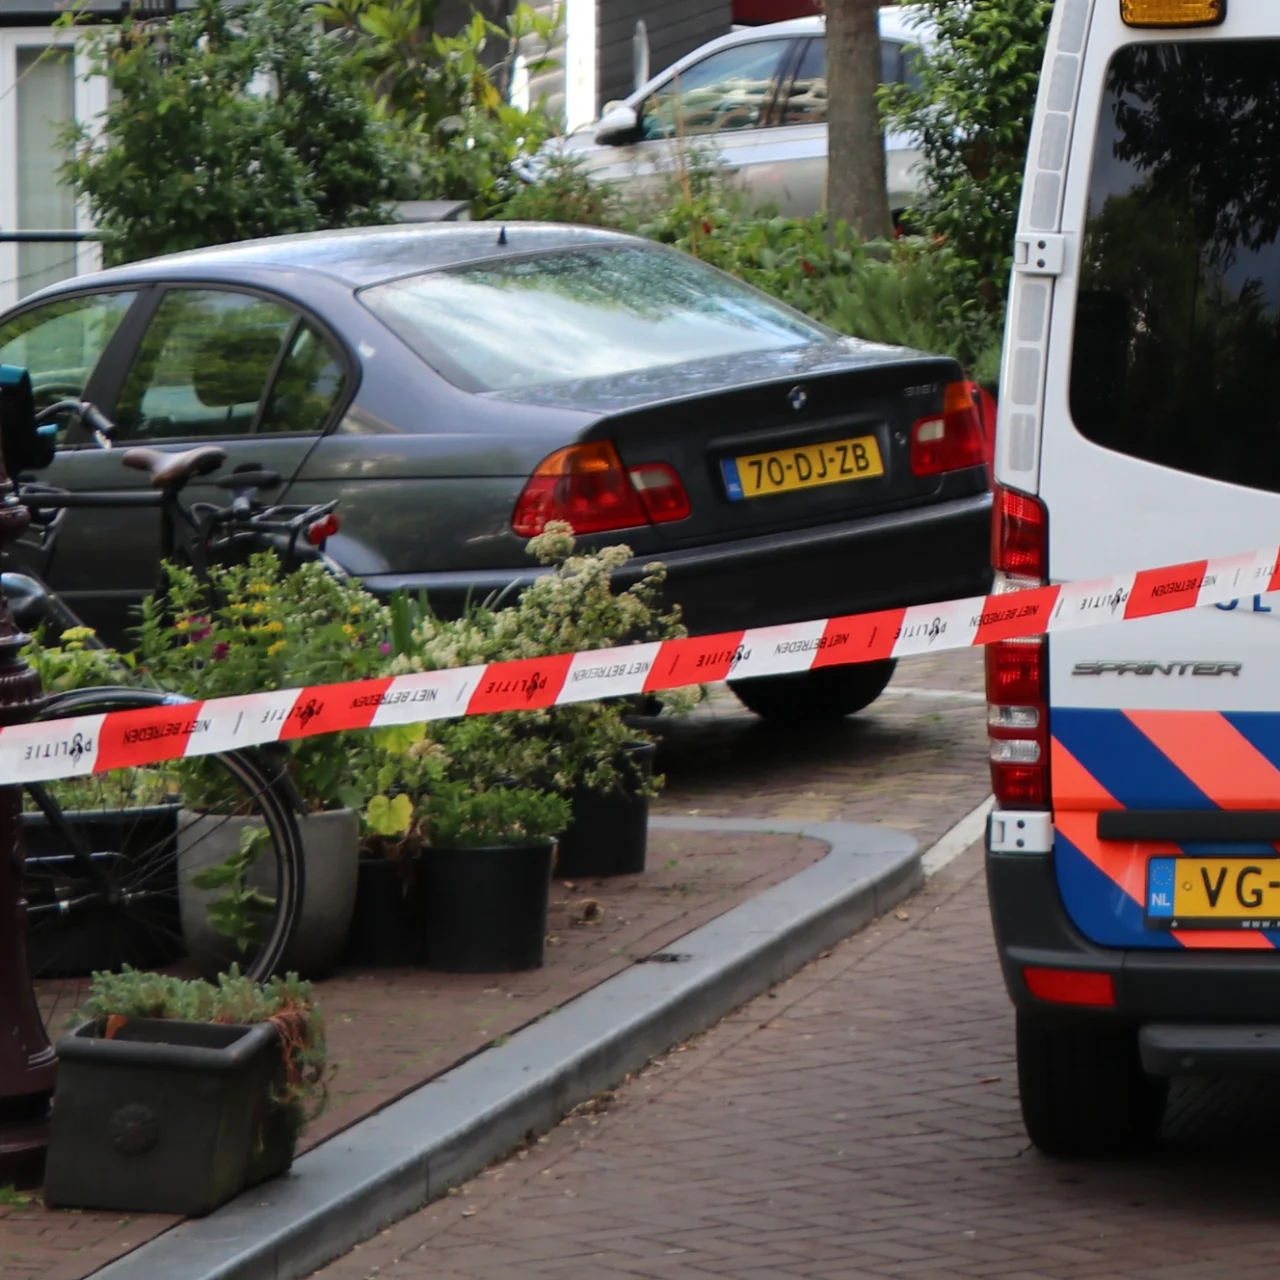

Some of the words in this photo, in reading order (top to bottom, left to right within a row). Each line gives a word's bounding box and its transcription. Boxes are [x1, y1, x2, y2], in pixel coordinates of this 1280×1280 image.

[748, 442, 870, 489] 70-DJ-ZB
[1151, 578, 1201, 597] BETREDEN
[1199, 574, 1219, 589] NIET
[969, 607, 1021, 628] BETREDEN
[1020, 603, 1040, 618] NIET
[774, 635, 829, 656] BETREDEN
[828, 632, 851, 648] NIET
[571, 663, 627, 682] BETREDEN
[626, 661, 652, 676] NIET
[1071, 660, 1243, 677] SPRINTER
[409, 688, 439, 704] NIET
[484, 671, 549, 702] POLITIE
[348, 691, 410, 711] BETREDEN
[260, 698, 325, 731] POLITIE
[122, 721, 183, 745] BETREDEN
[181, 718, 212, 734] NIET
[24, 732, 92, 767] POLITIE
[1151, 892, 1171, 907] NL
